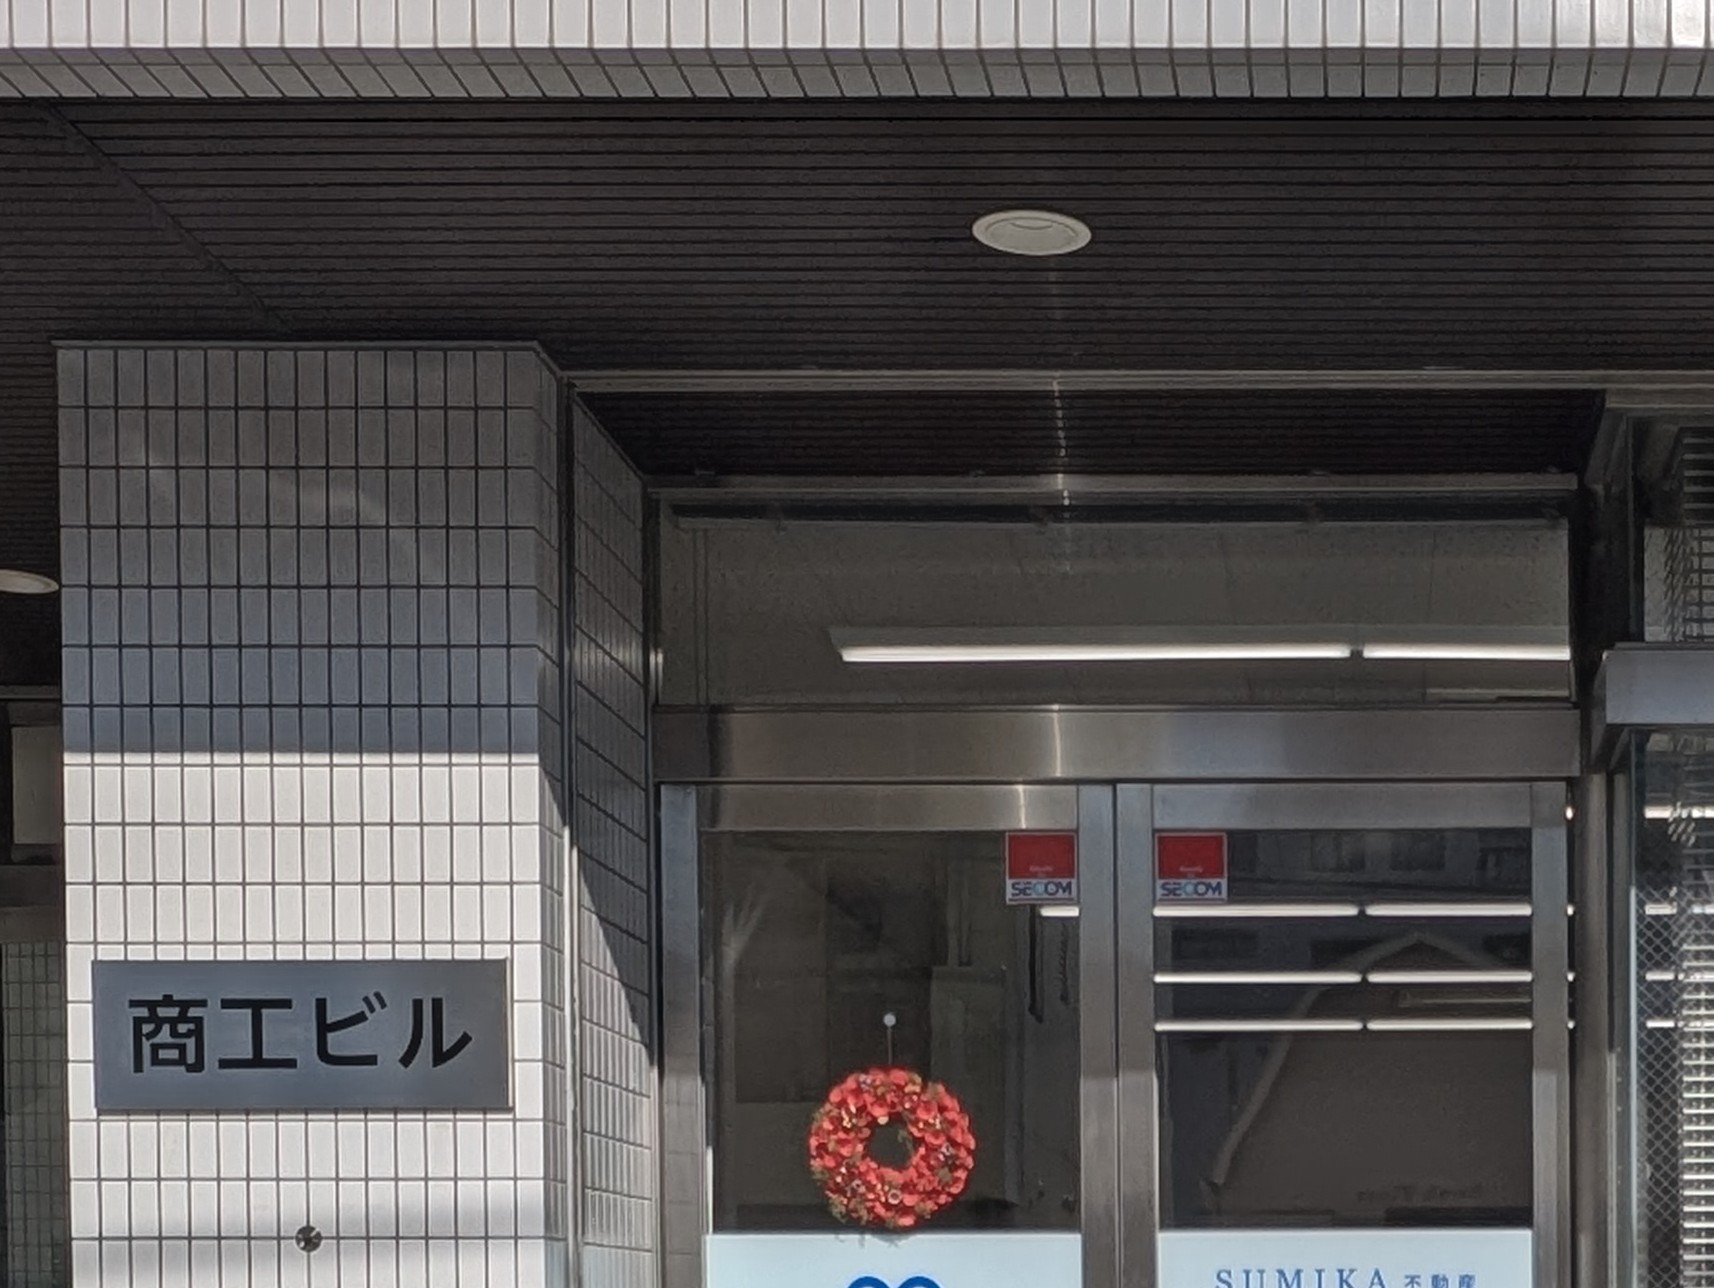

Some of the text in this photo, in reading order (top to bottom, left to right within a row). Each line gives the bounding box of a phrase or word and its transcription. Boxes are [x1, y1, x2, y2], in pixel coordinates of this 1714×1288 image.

[1010, 881, 1072, 897] SECOM
[1160, 881, 1223, 897] SECOM
[127, 990, 473, 1074] 商工ビル
